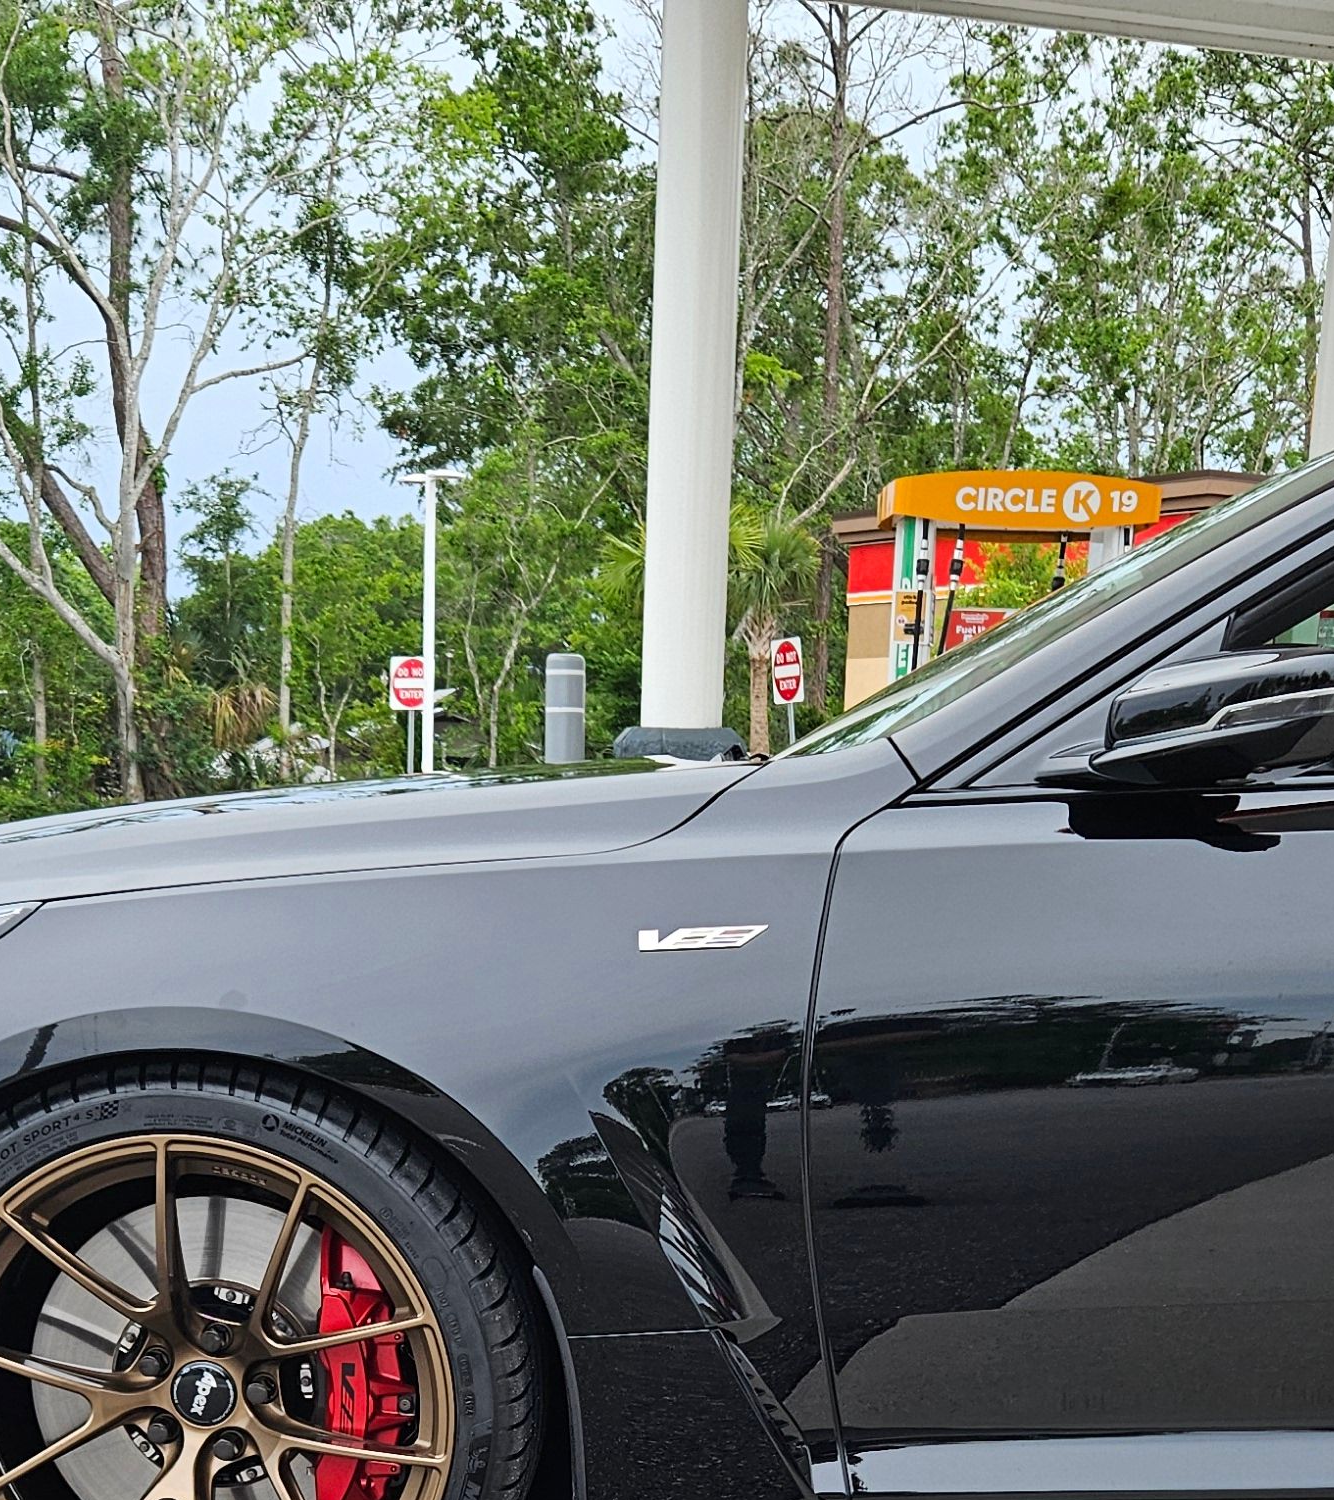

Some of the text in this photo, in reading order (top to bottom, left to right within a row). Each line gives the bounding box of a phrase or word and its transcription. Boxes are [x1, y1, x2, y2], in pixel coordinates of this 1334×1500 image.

[955, 486, 1139, 519] CIRCLE K 19
[23, 1115, 72, 1146] SPORT
[283, 1121, 328, 1147] MICHELIN
